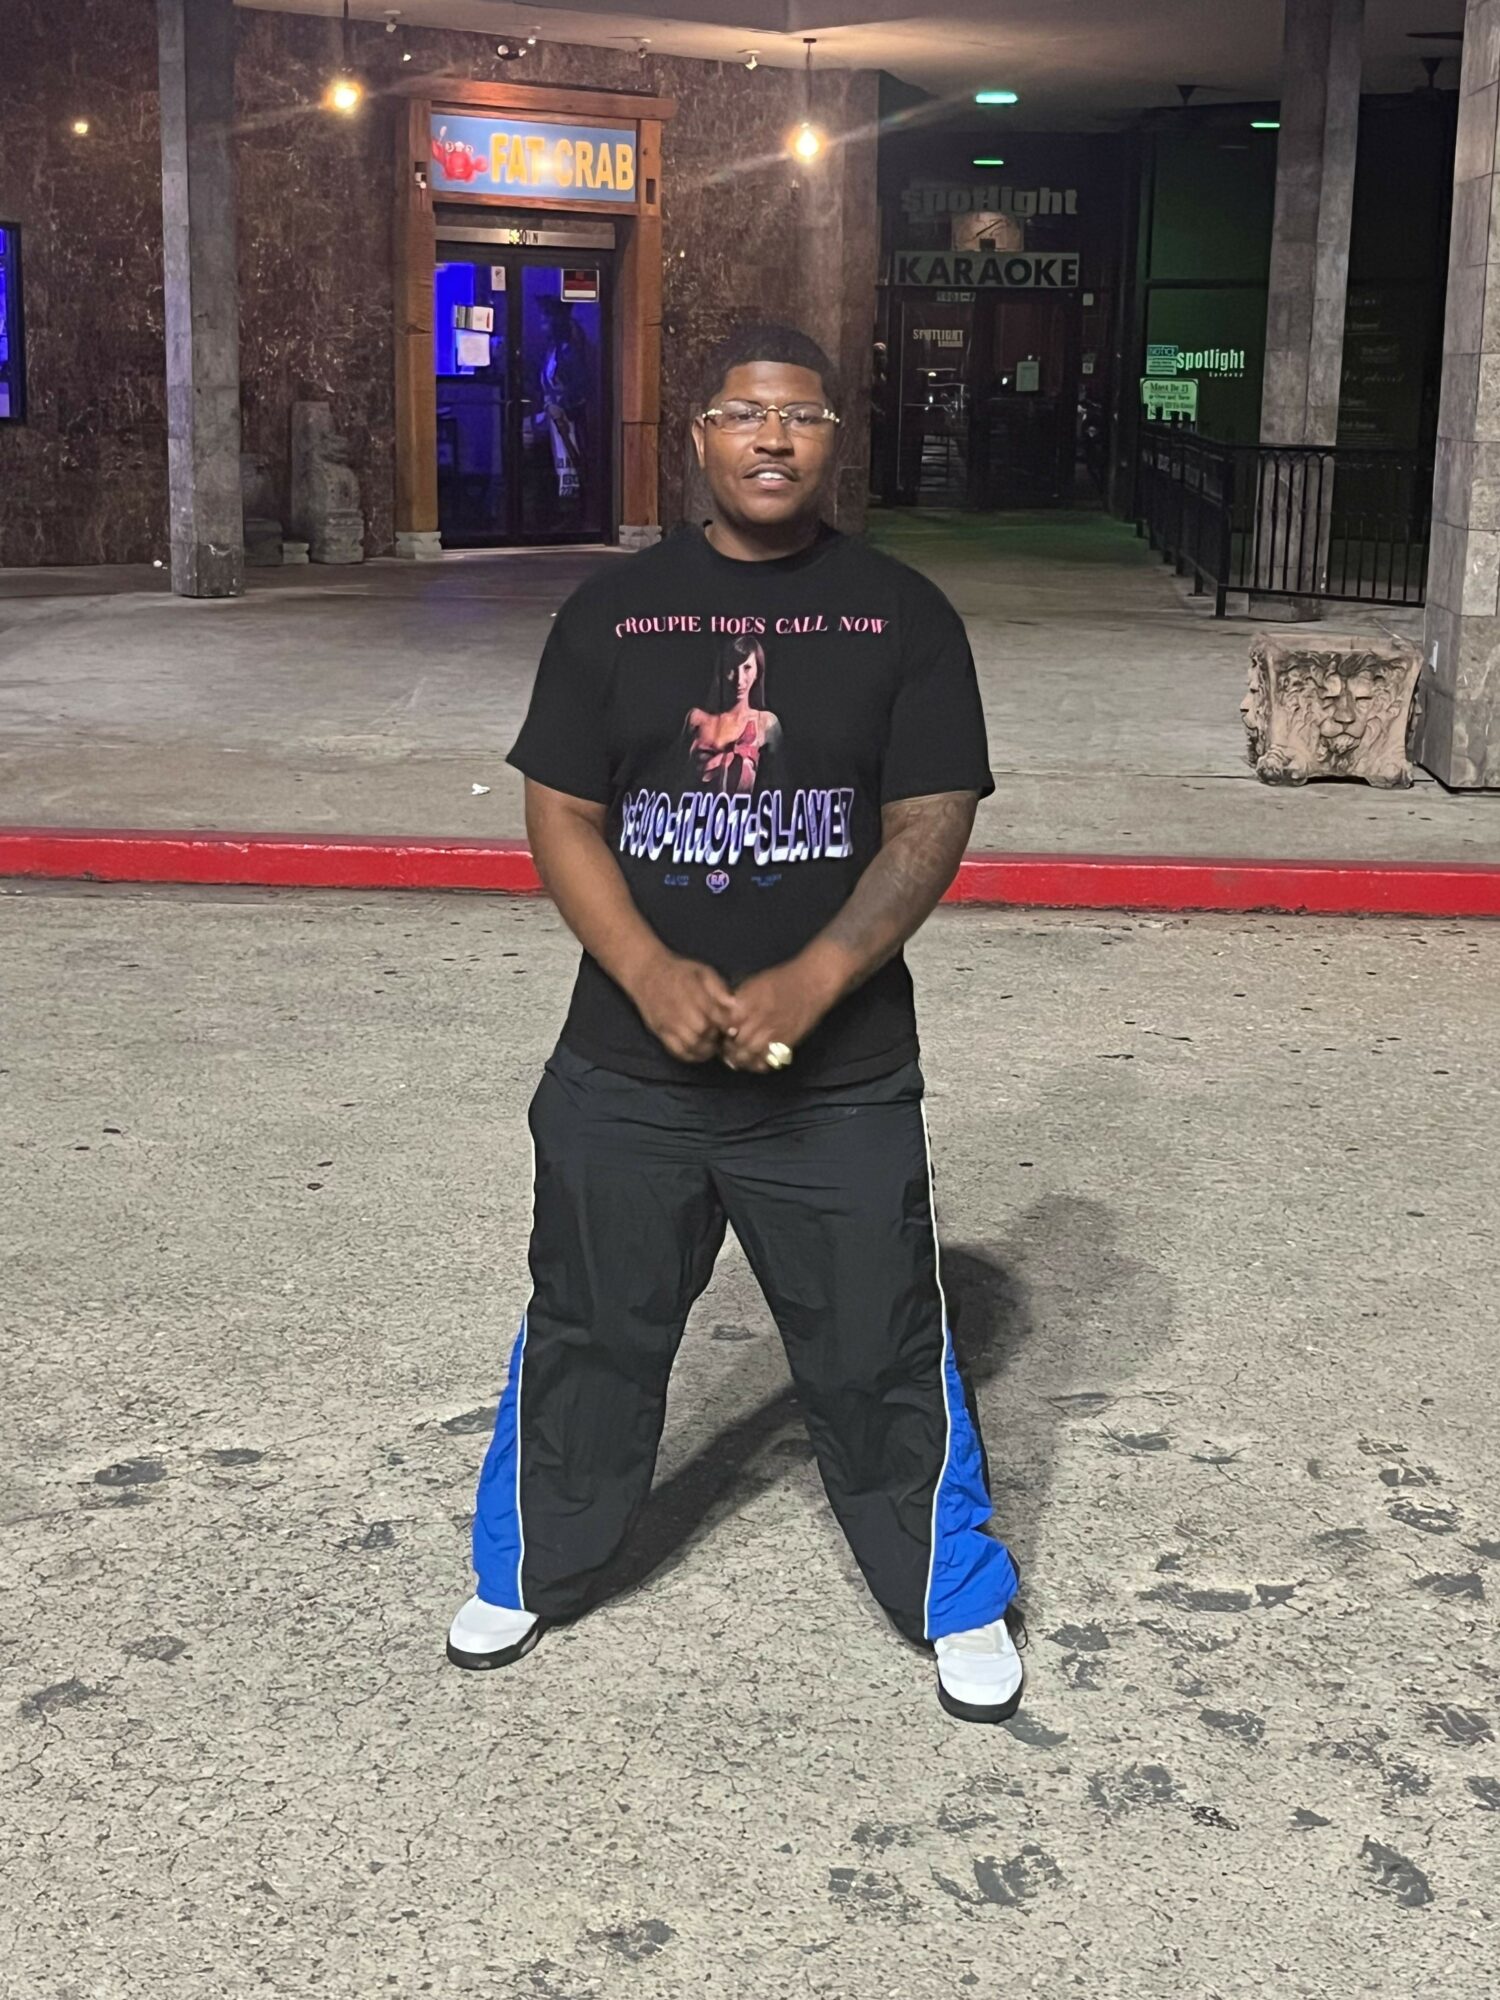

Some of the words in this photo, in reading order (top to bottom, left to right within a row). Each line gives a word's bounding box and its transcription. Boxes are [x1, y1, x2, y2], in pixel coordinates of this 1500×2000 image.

[490, 132, 544, 184] FAT
[555, 138, 634, 190] CRAB
[901, 185, 1078, 222] spotlight
[898, 257, 1077, 286] KARAOKE
[1177, 348, 1244, 371] spotlight
[709, 616, 765, 634] HOES
[774, 614, 828, 634] CALL
[837, 615, 889, 634] NOW
